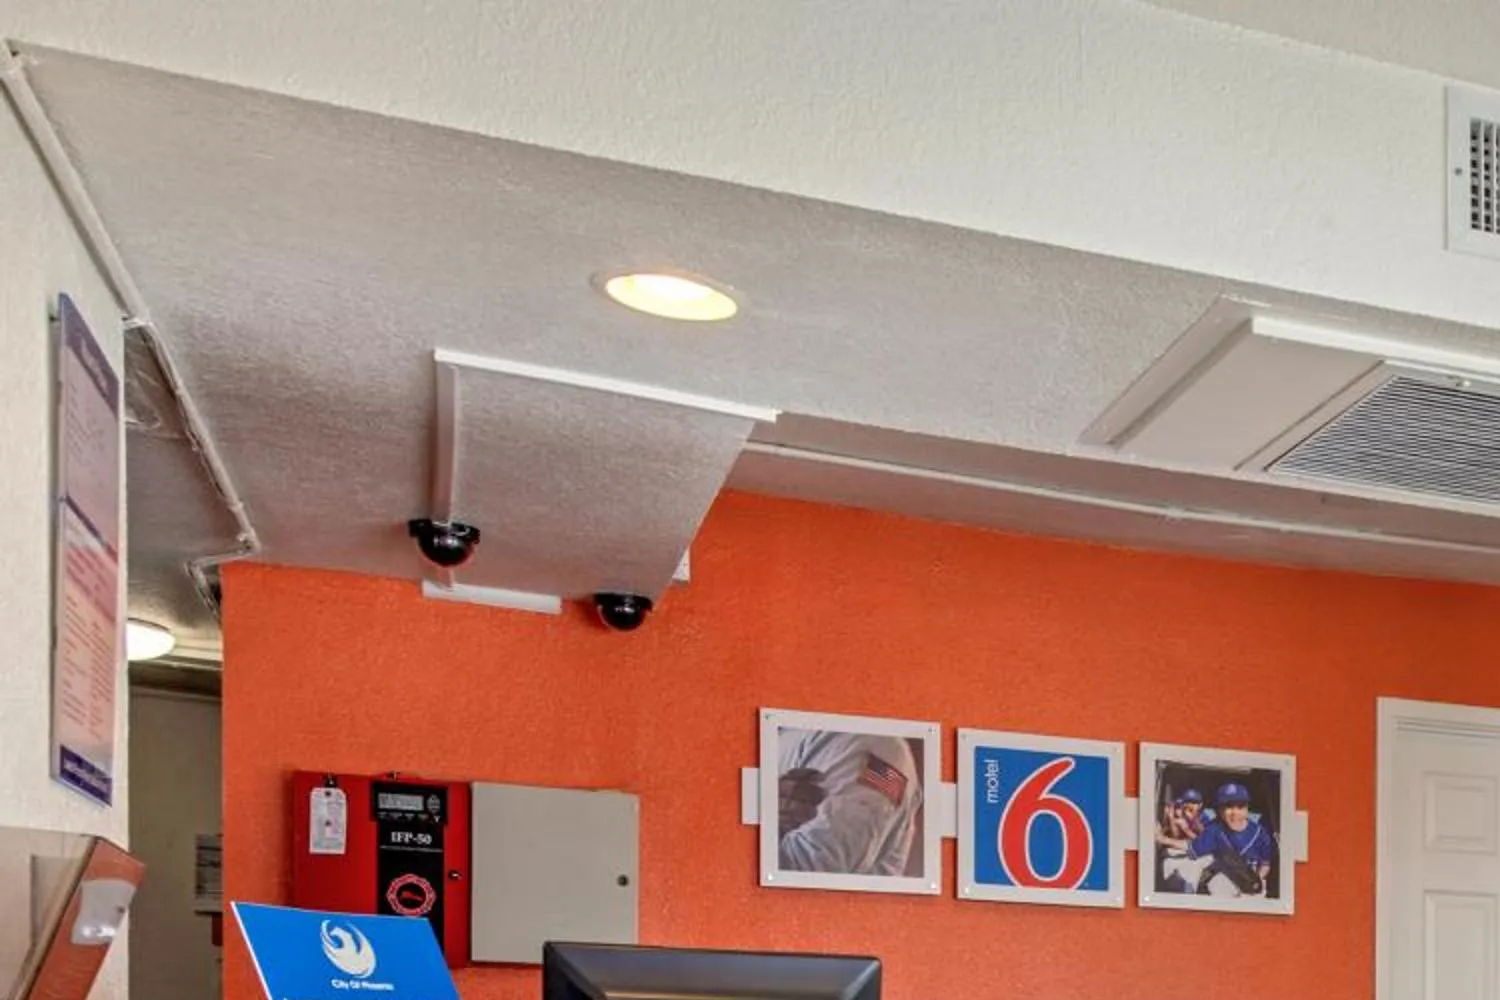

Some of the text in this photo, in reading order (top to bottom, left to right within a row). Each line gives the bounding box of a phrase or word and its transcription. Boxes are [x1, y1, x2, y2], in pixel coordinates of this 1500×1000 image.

[391, 831, 433, 845] IFP-50
[984, 756, 1093, 890] motel 6
